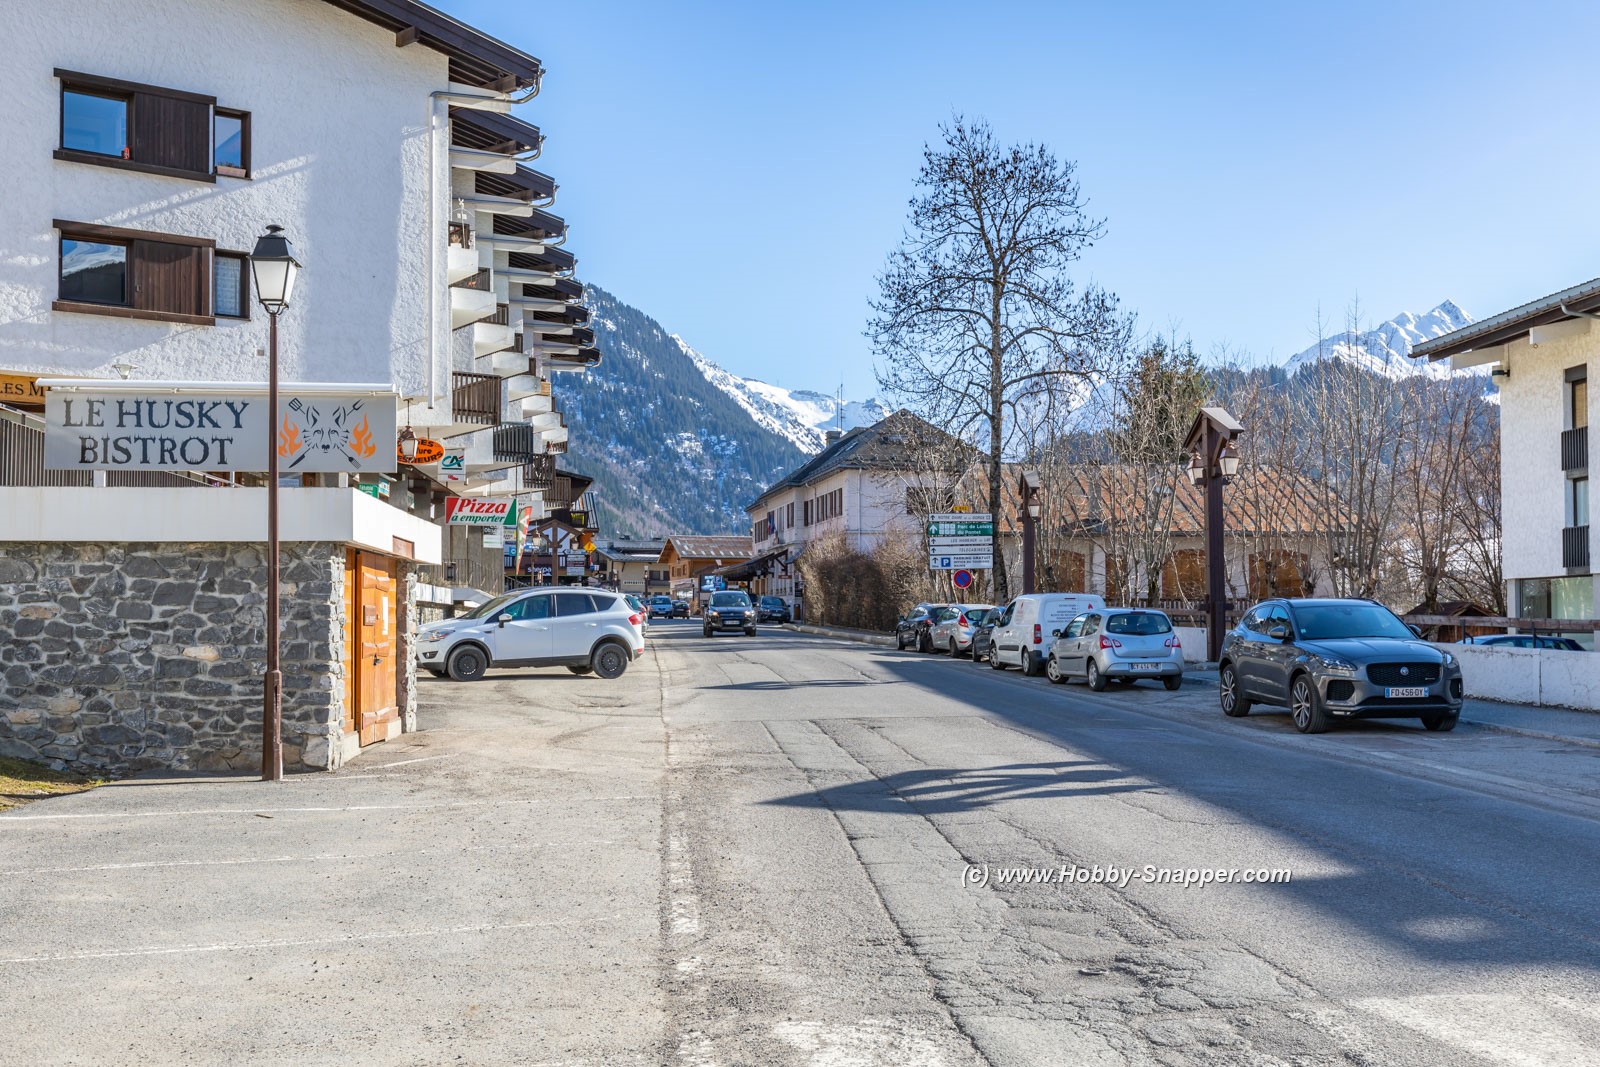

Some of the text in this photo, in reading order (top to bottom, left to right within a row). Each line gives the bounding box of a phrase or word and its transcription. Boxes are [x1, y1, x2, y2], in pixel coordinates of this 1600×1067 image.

[63, 397, 251, 430] LE HUSKY
[79, 435, 235, 465] BISTROT
[458, 498, 507, 513] Pizza
[451, 513, 505, 524] à emporter
[527, 567, 552, 575] serpa
